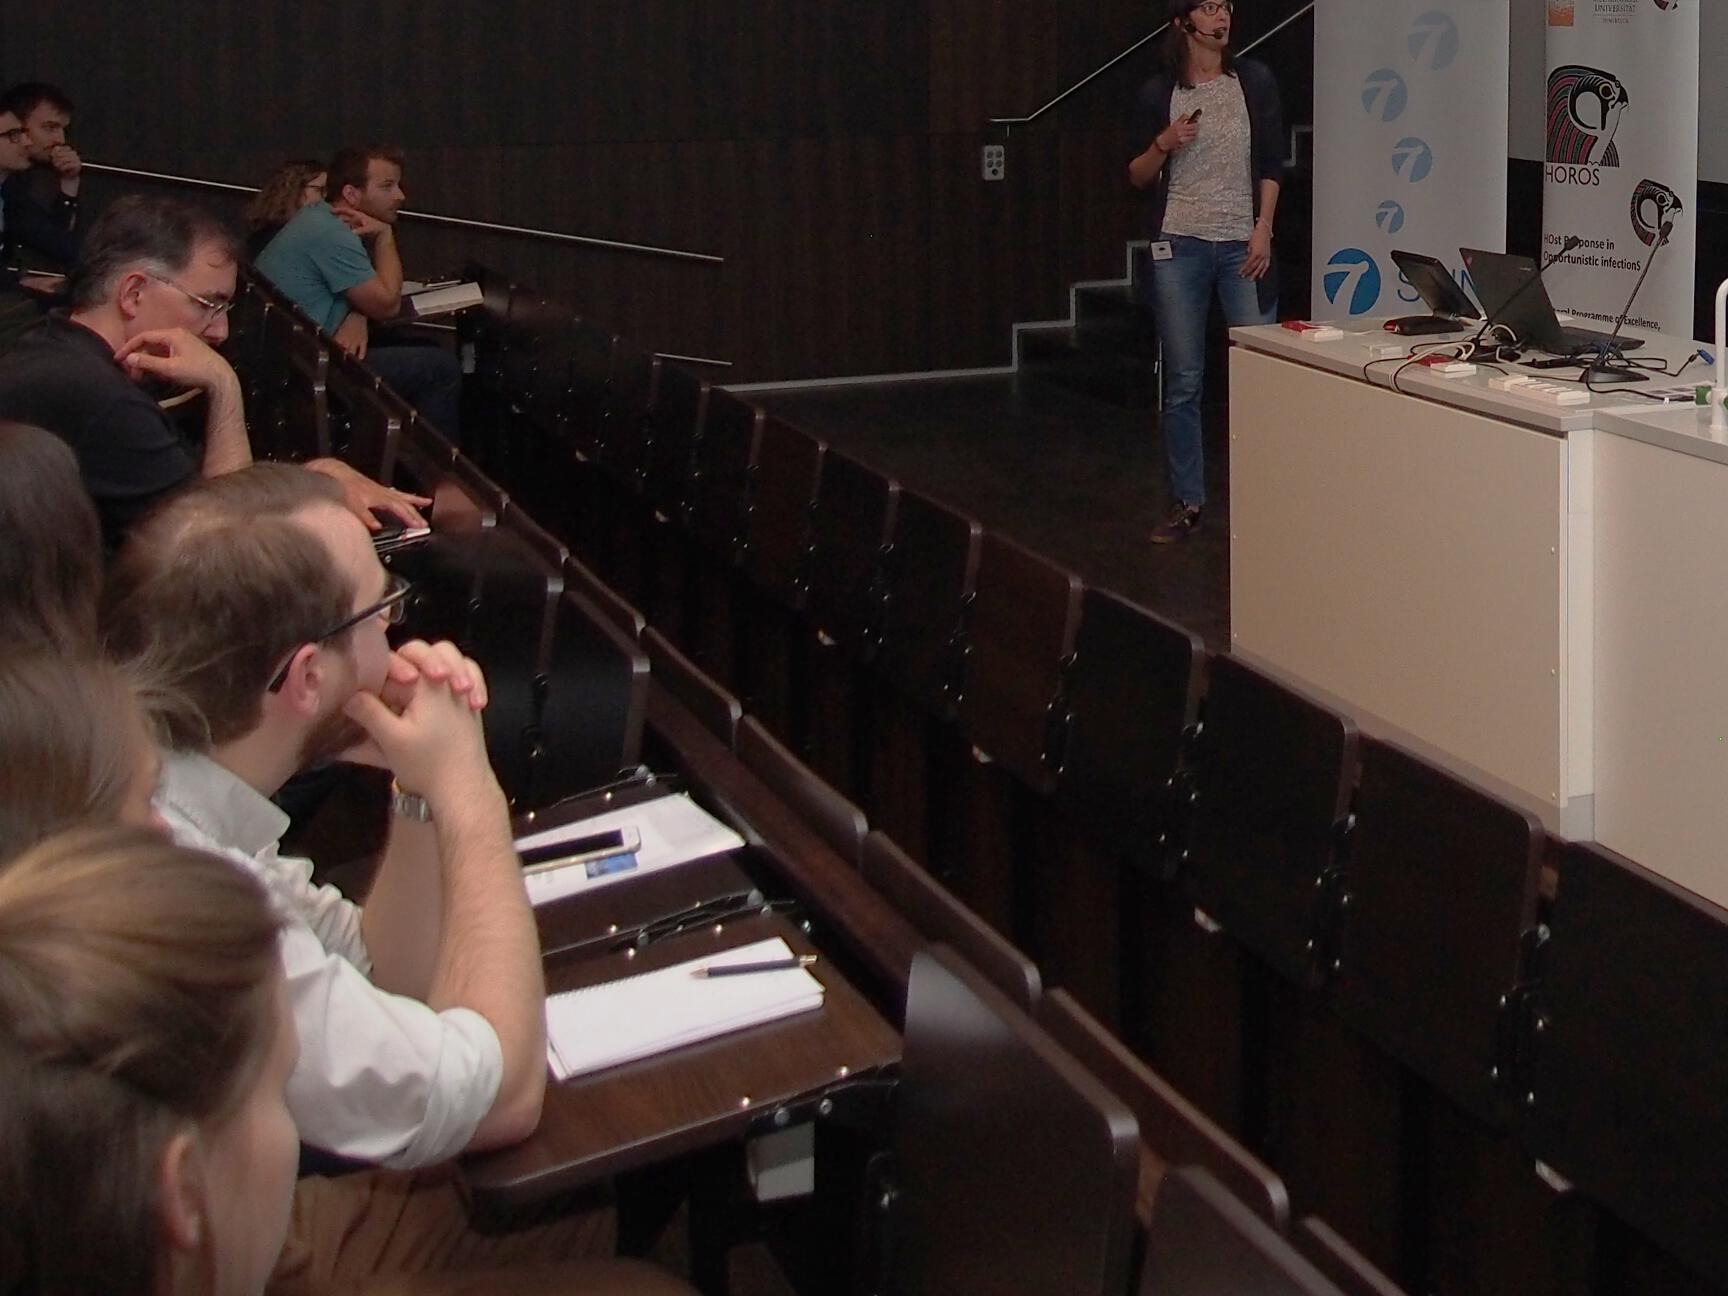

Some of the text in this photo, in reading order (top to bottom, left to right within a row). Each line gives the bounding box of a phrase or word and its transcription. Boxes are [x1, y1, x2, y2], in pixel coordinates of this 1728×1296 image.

[1545, 165, 1600, 187] HOROS
[1544, 233, 1562, 245] HOst
[1606, 239, 1615, 250] in
[1601, 256, 1641, 272] infectionS
[1624, 315, 1661, 332] Excellence,
